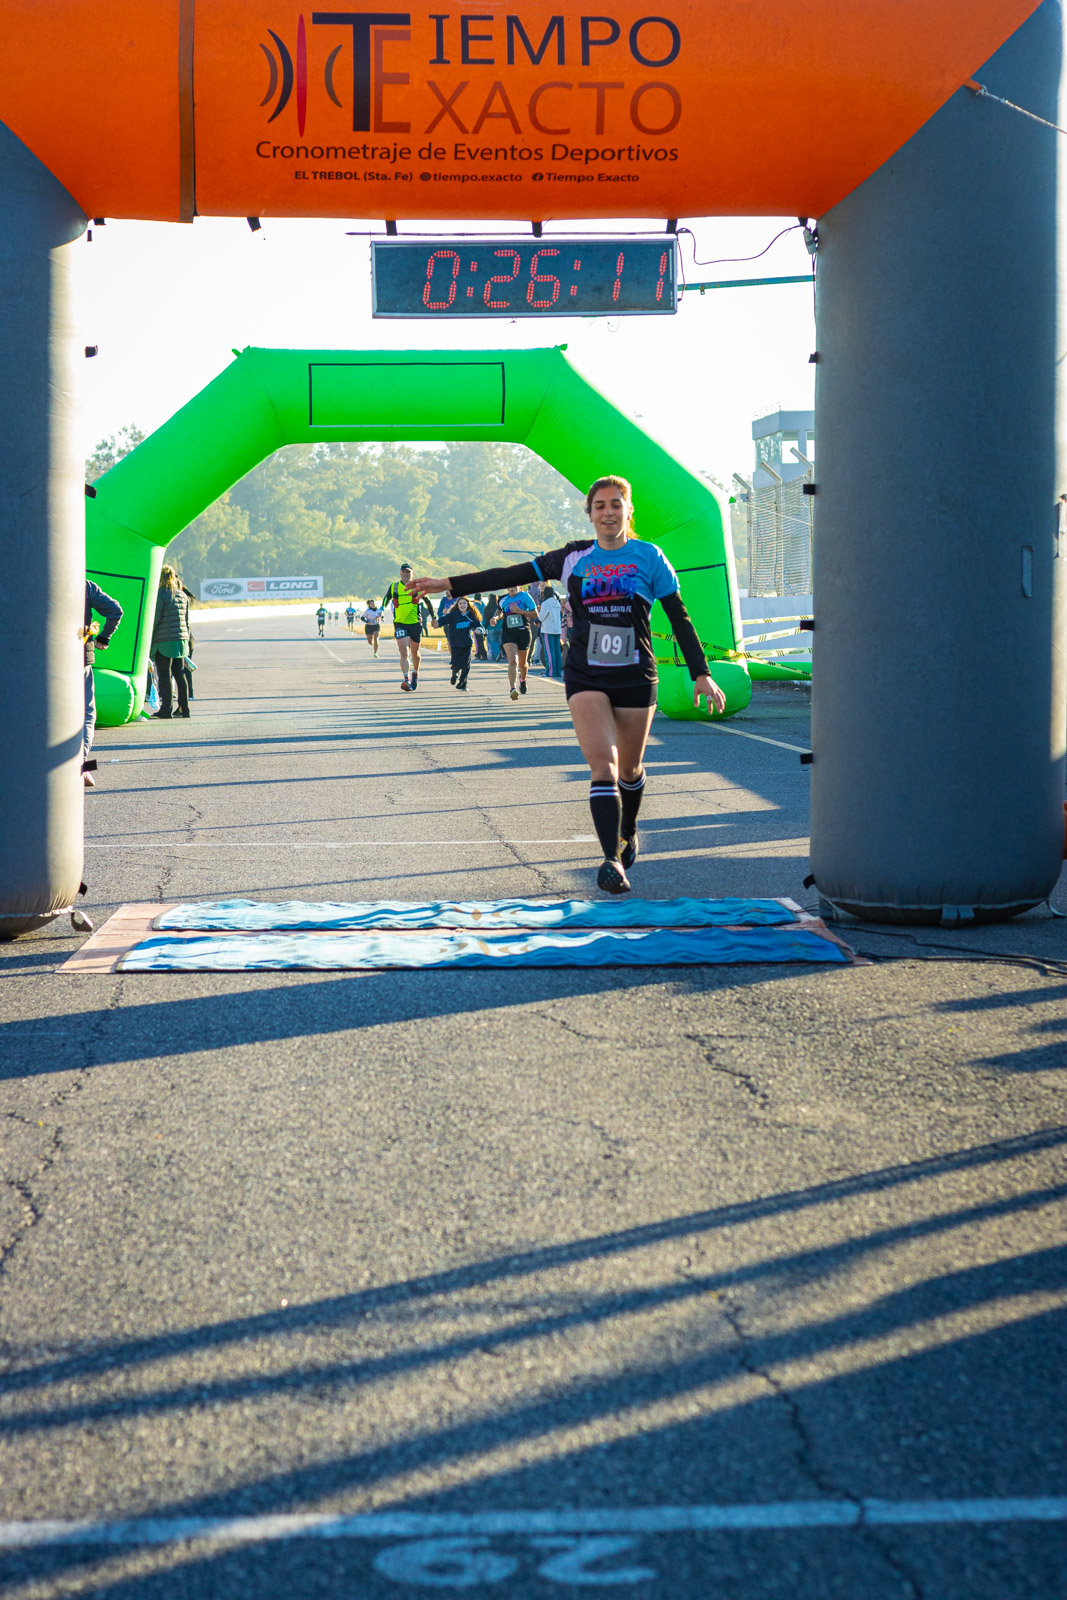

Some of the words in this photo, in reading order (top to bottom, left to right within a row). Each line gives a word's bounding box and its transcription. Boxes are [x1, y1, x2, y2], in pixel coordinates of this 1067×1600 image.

[255, 141, 412, 164] Cronometraje
[418, 142, 446, 160] de
[453, 143, 544, 161] Eventos
[551, 143, 679, 165] Deportivos
[294, 171, 309, 180] EL
[312, 171, 360, 180] TREBOL
[363, 171, 391, 181] (Sta.
[394, 172, 413, 181] Fe)
[546, 172, 594, 183] Tiempo
[597, 173, 639, 182] Exacto
[210, 583, 236, 594] Ford
[269, 581, 315, 590] LONG
[601, 633, 623, 655] 09
